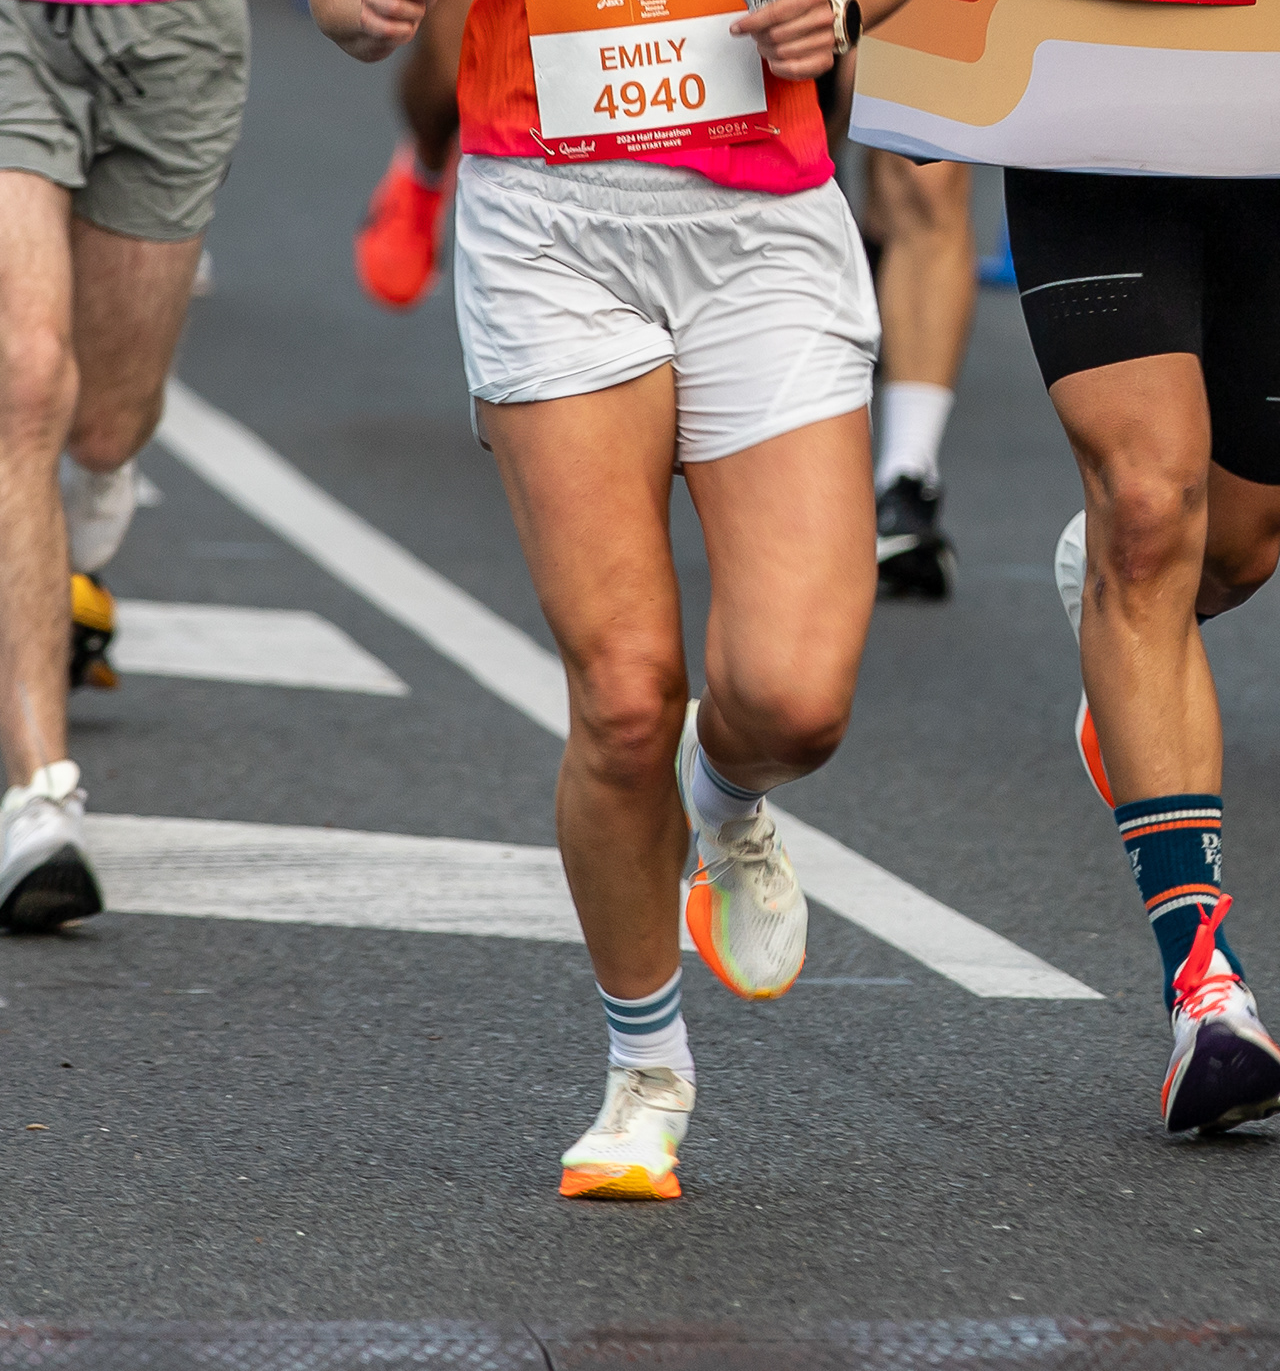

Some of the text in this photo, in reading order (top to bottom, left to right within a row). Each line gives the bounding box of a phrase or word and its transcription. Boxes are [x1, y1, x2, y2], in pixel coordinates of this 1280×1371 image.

[599, 37, 687, 71] EMILY
[593, 73, 707, 120] 4940
[616, 127, 692, 145] 2024 Half Marathon
[707, 121, 748, 136] NOOSA
